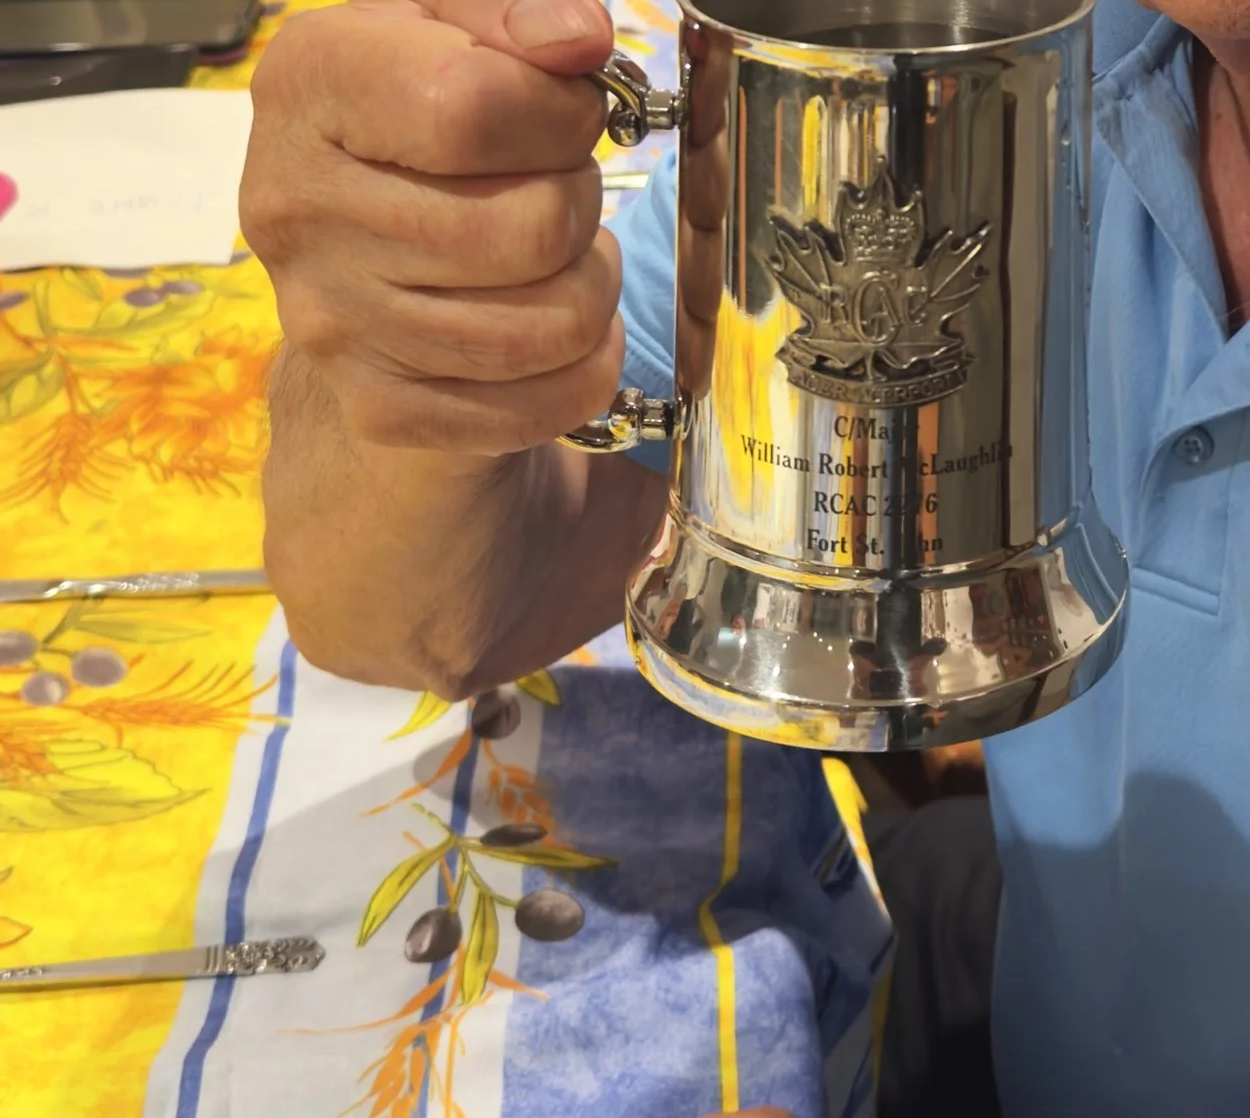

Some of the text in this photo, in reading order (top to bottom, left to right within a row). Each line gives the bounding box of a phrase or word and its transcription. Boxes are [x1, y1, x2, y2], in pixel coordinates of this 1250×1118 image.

[834, 415, 921, 444] C/Maj
[740, 434, 1013, 479] William Robert cLaughli
[814, 491, 877, 516] RCAC
[807, 528, 943, 556] Fort St. hn
